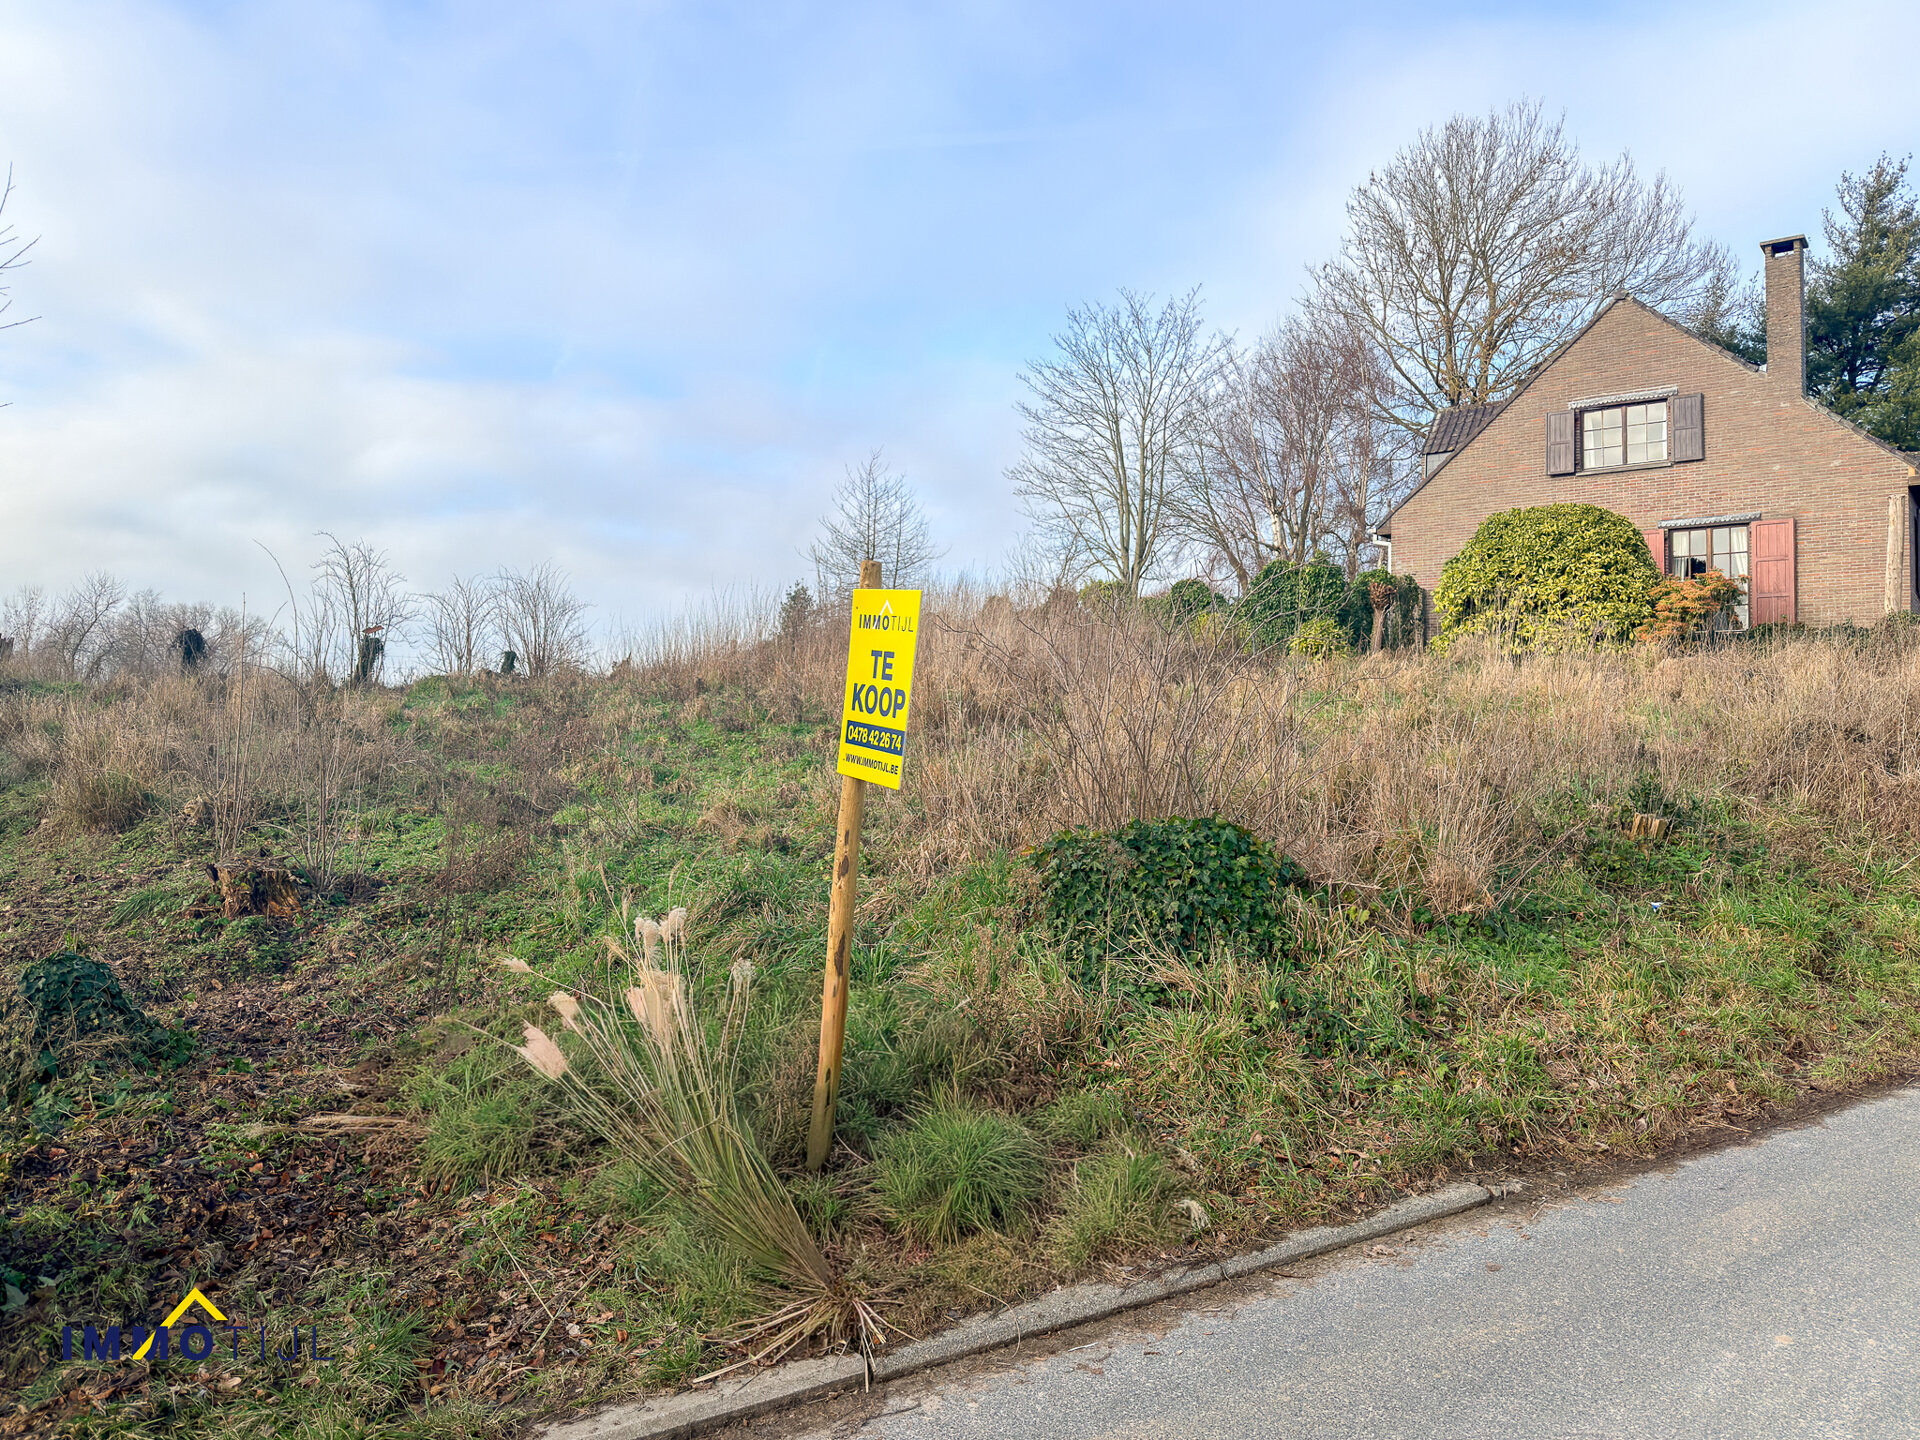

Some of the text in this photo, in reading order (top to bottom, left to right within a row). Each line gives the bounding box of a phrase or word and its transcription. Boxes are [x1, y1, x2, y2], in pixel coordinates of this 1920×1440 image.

[859, 614, 914, 632] IMMOTIJL
[871, 650, 895, 681] TE
[851, 683, 906, 719] KOOP
[848, 725, 902, 751] 0478 42 26 74
[845, 753, 899, 775] WWW.IMMOTIJL.BE
